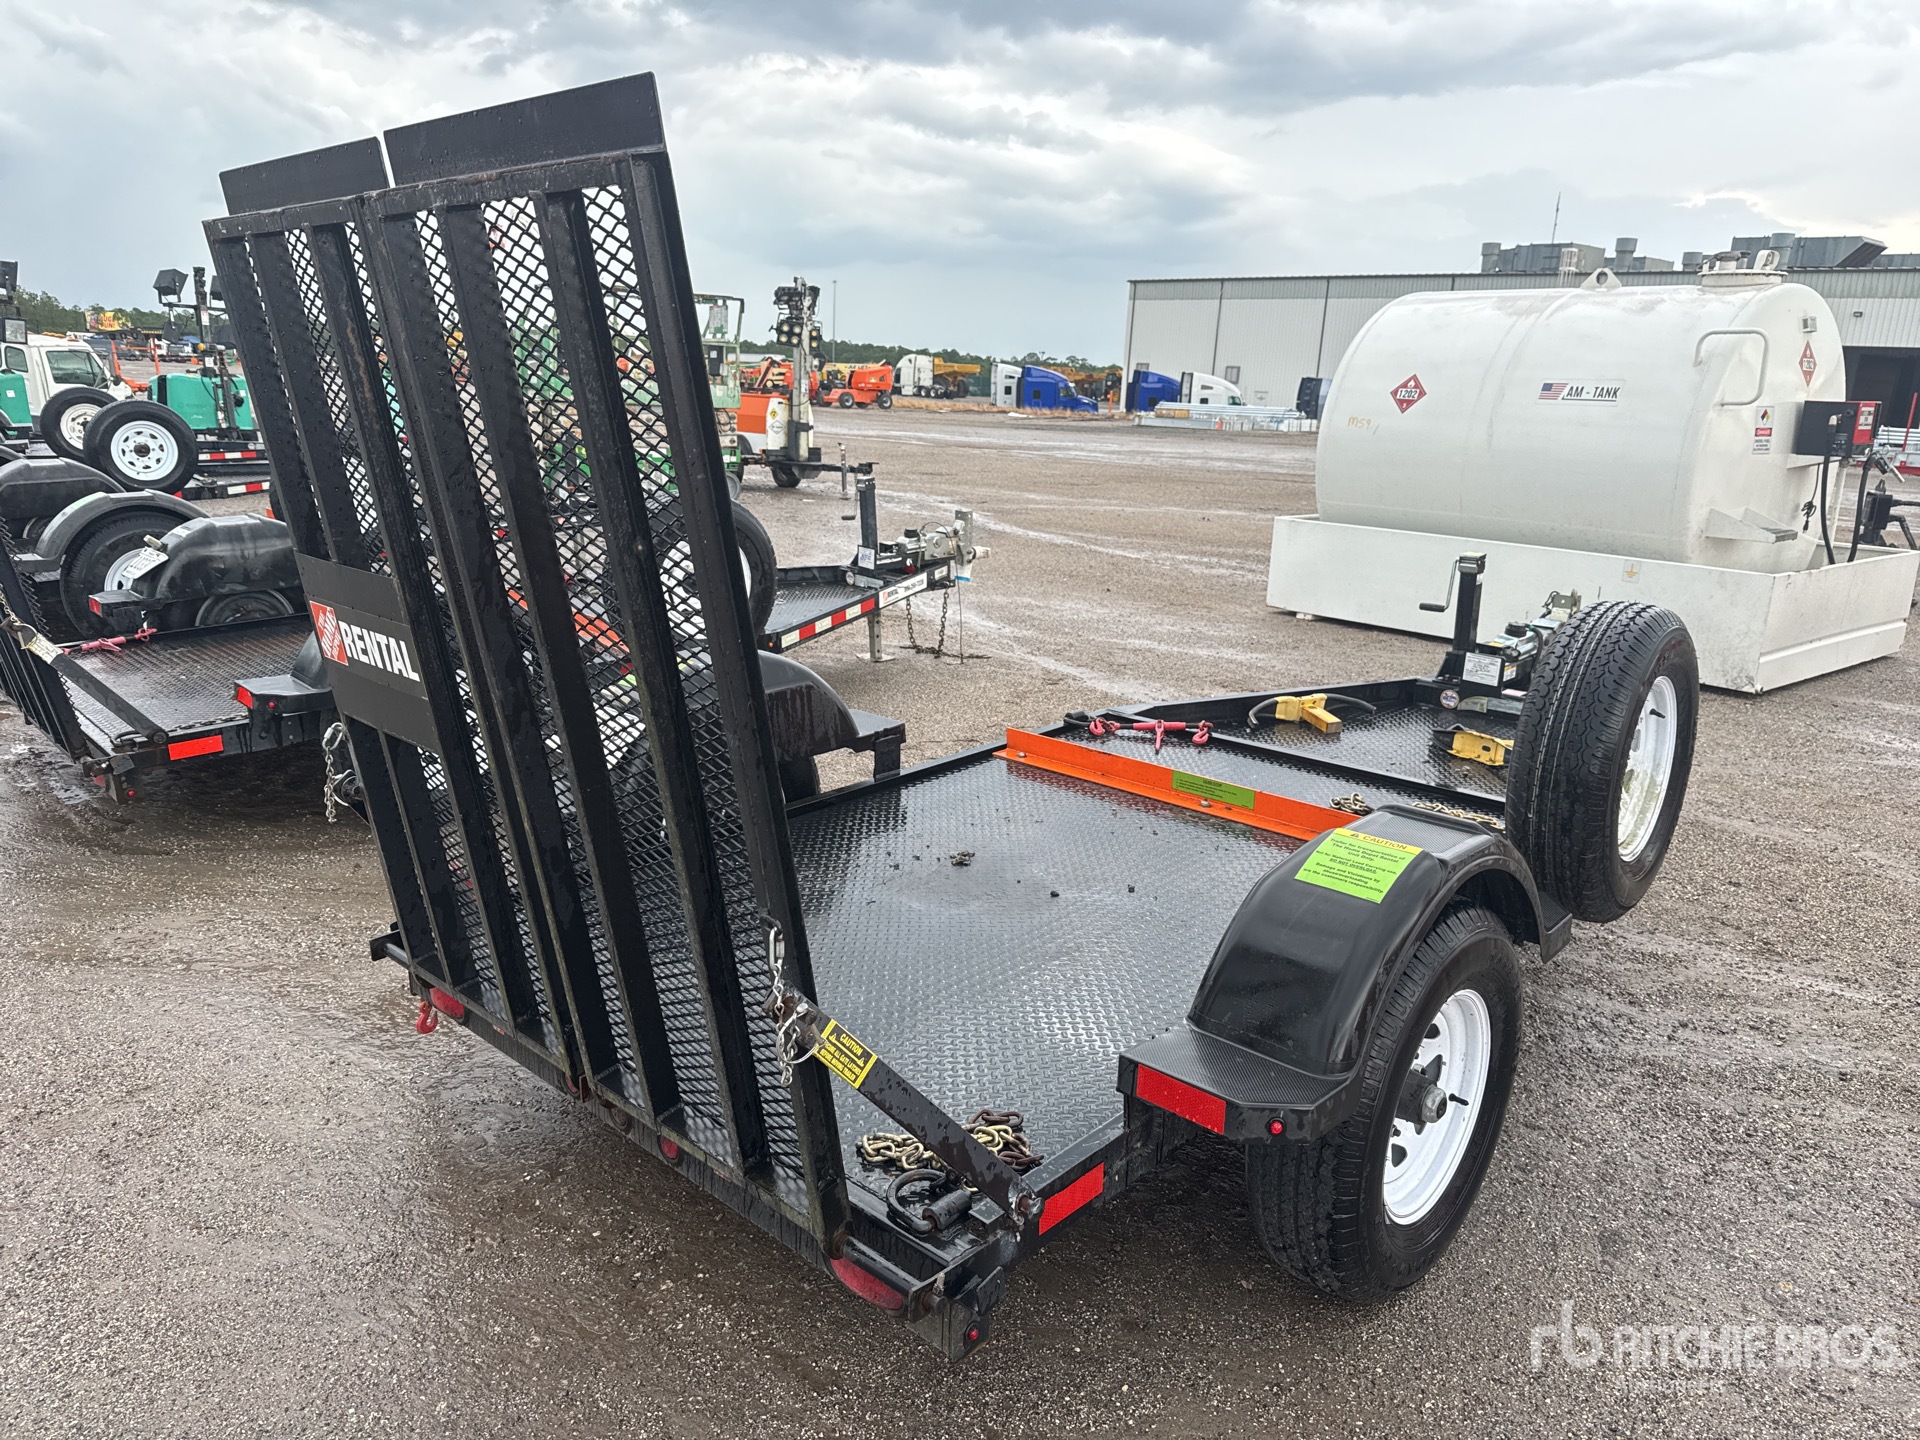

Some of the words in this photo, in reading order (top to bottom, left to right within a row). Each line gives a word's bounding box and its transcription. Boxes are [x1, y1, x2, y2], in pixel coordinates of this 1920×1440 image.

[1398, 389, 1418, 398] 1202
[1566, 386, 1584, 398] AM
[1592, 386, 1620, 398] TANK
[338, 620, 420, 682] RENTAL
[1363, 836, 1407, 849] CAUTION
[1357, 846, 1398, 858] transportation
[1347, 871, 1372, 880] Violations
[840, 1033, 863, 1056] CAUTION
[840, 1055, 849, 1064] GATE
